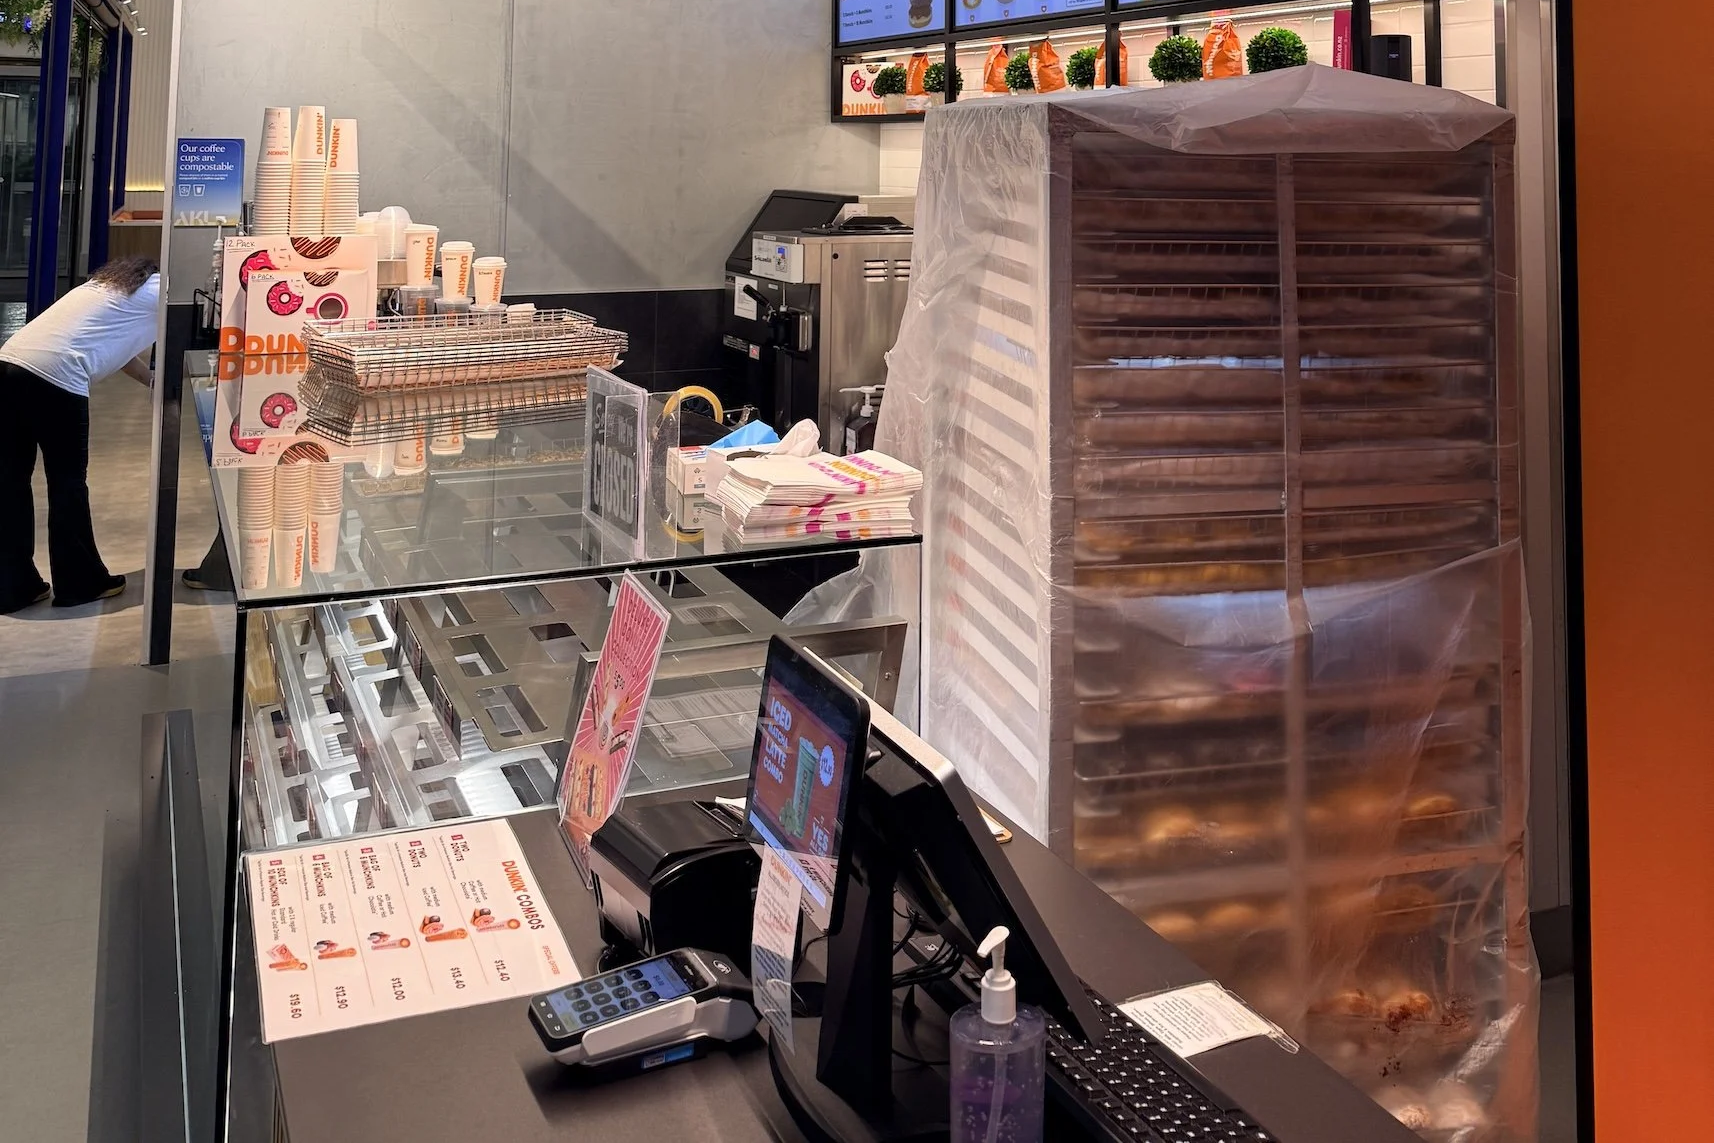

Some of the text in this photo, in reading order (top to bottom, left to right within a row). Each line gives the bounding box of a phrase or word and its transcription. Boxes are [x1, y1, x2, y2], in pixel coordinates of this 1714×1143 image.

[316, 112, 324, 155] DUNKIN'
[330, 125, 340, 168] DUNKIN'
[180, 144, 226, 153] Our coffee
[180, 154, 200, 163] cups
[180, 162, 234, 172] compostable
[225, 240, 236, 248] 12
[424, 236, 434, 281] DUNKIN'
[458, 255, 468, 296] DUNKIN'
[492, 269, 502, 302] DUNKIN'
[593, 440, 635, 525] CLOSED
[770, 696, 792, 732] ICED
[765, 736, 787, 769] LATTE
[763, 757, 784, 784] COMBO
[458, 840, 470, 852] TWO
[812, 822, 830, 850] YES
[408, 850, 422, 868] DONUTS
[416, 847, 428, 859] TWO
[450, 843, 464, 862] DONUTS
[312, 866, 326, 898] MUNCHKINS
[360, 860, 375, 890] MUNCHKINS
[268, 876, 280, 908] MUNCHKINS
[502, 860, 545, 930] DUNKIN' COMBOS
[450, 967, 466, 990] $13.40
[494, 960, 510, 982] $12.40
[334, 986, 349, 1010] $12.90
[391, 977, 406, 1001] $12.00
[289, 994, 302, 1019] $19.60
